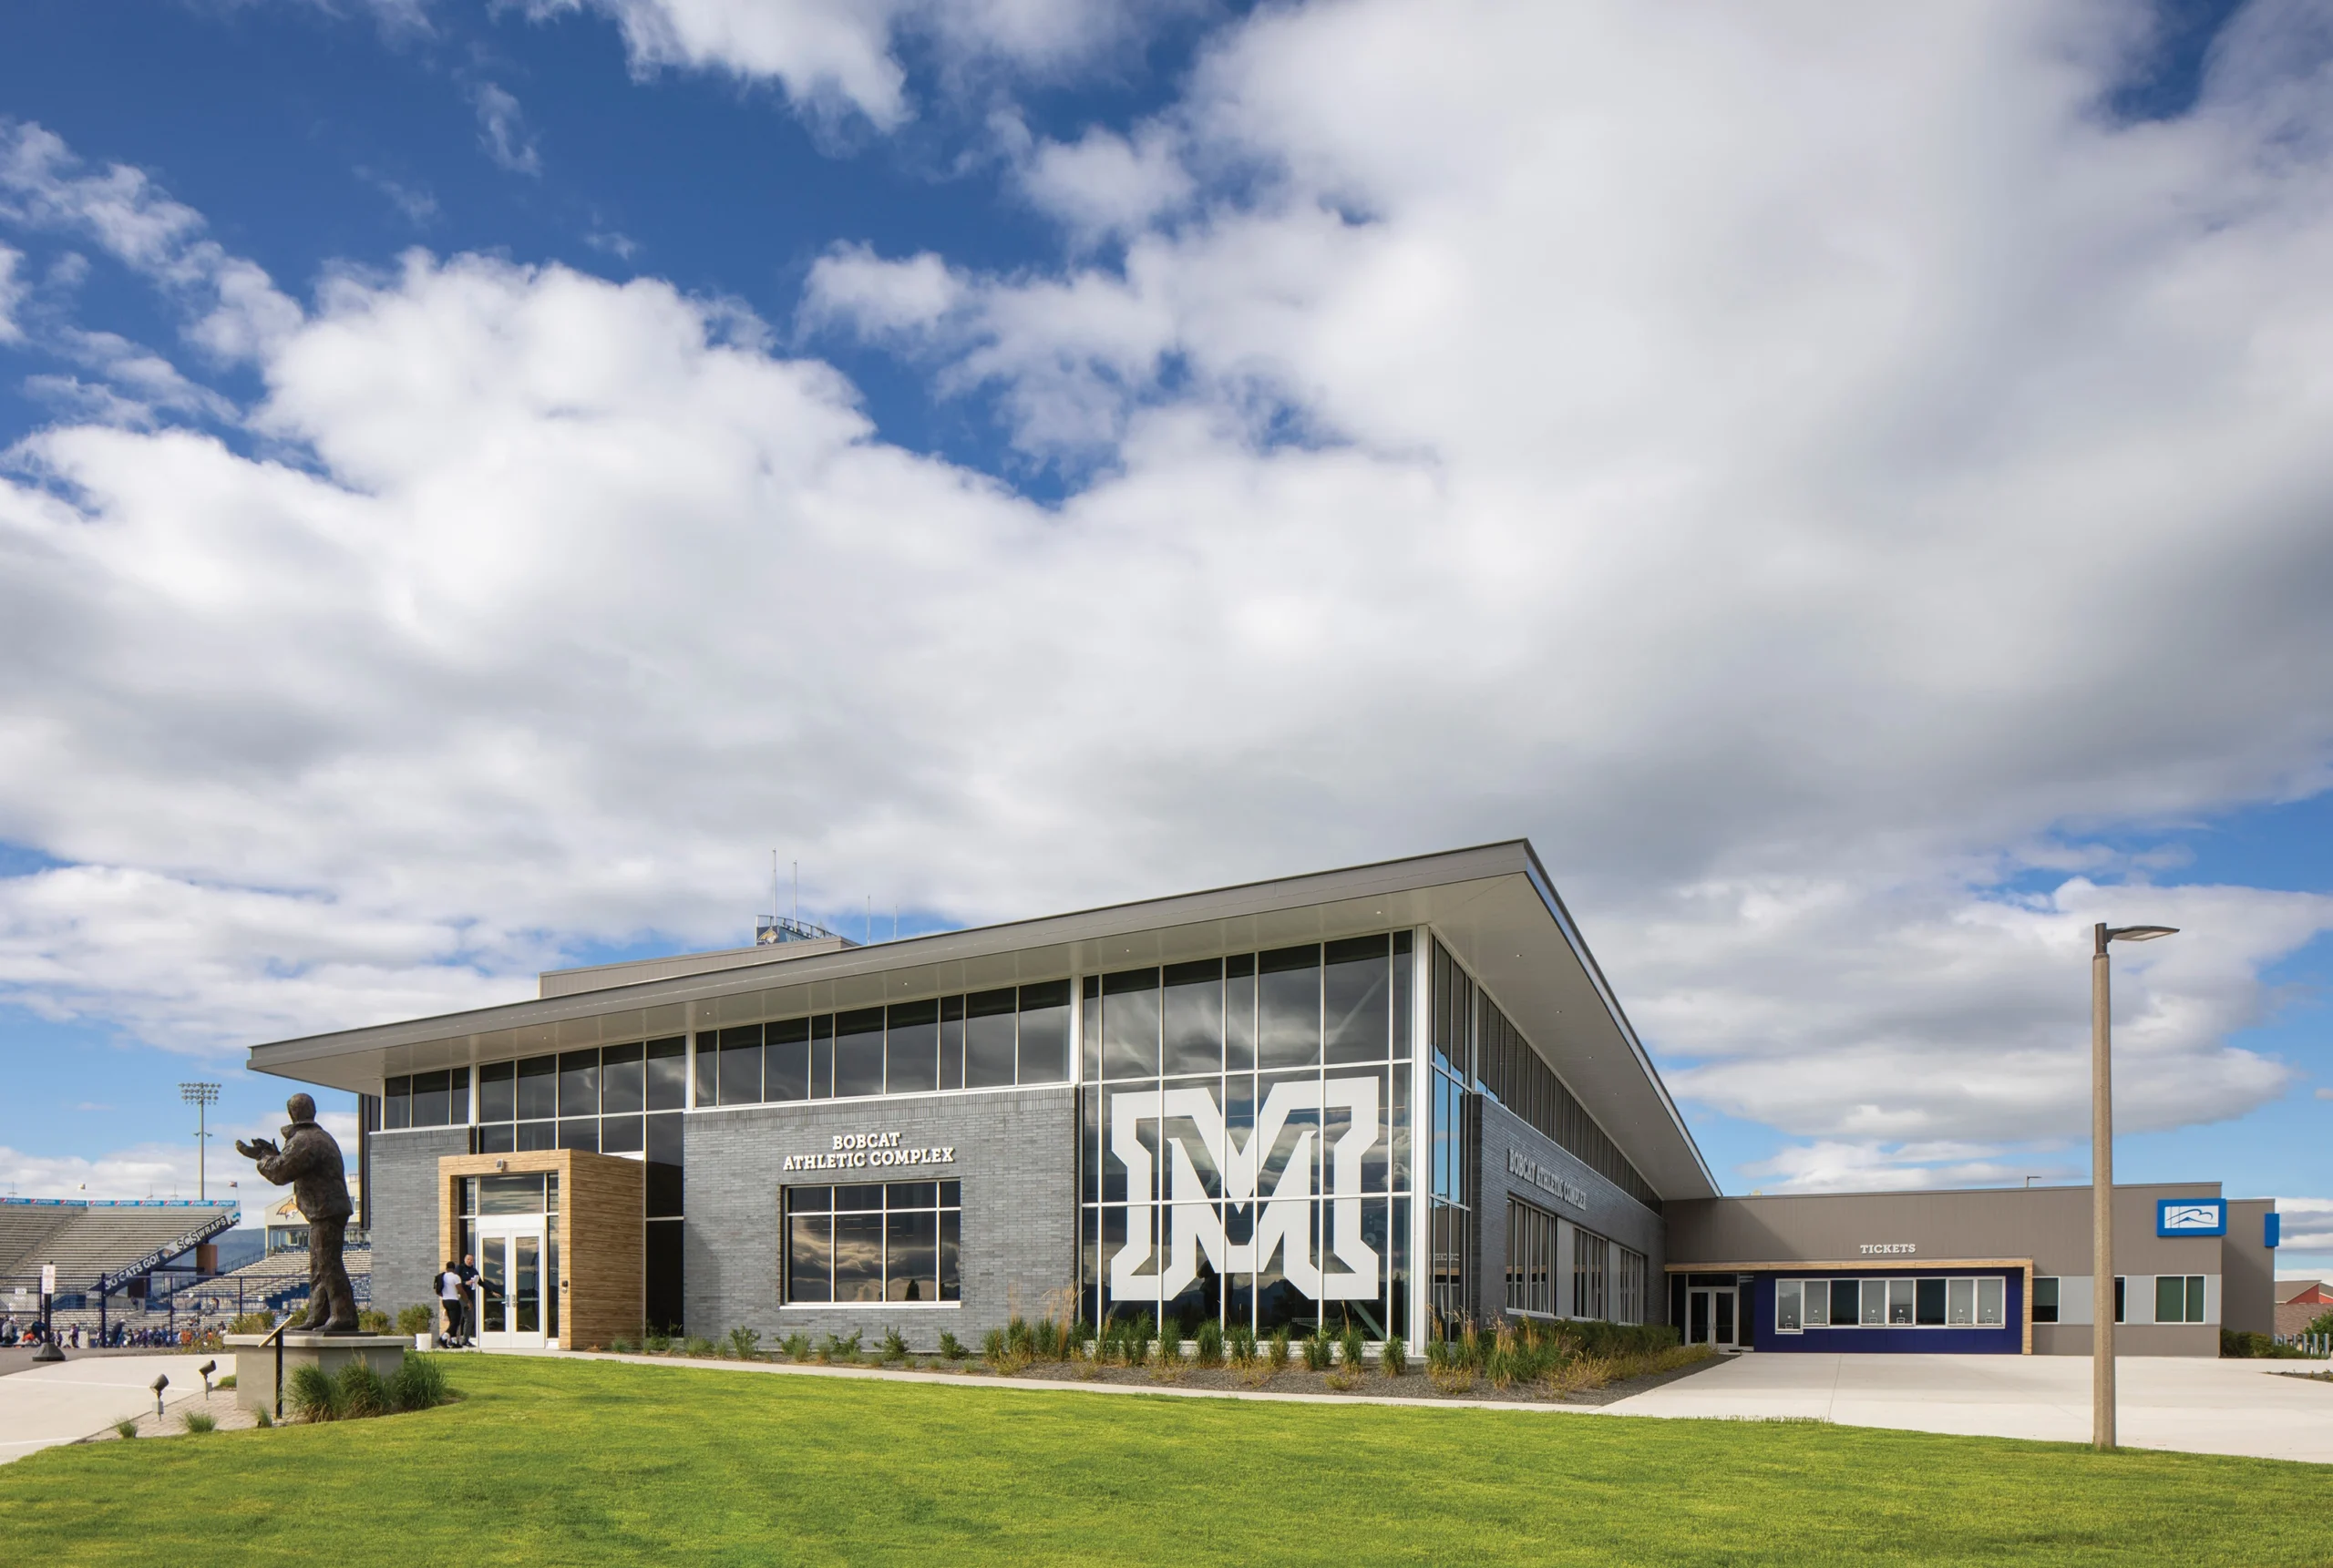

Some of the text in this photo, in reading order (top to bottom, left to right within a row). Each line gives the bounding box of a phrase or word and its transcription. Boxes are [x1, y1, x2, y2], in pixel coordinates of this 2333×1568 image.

[833, 1132, 901, 1150] BOBCAT
[783, 1147, 955, 1171] ATHLETIC COMPLEX
[1111, 1076, 1379, 1301] M
[1508, 1148, 1587, 1211] BOBCAT ATHLETIC COMPLEX
[1860, 1244, 1917, 1254] TICKETS
[118, 1262, 143, 1281] CATS
[143, 1254, 159, 1269] GO!
